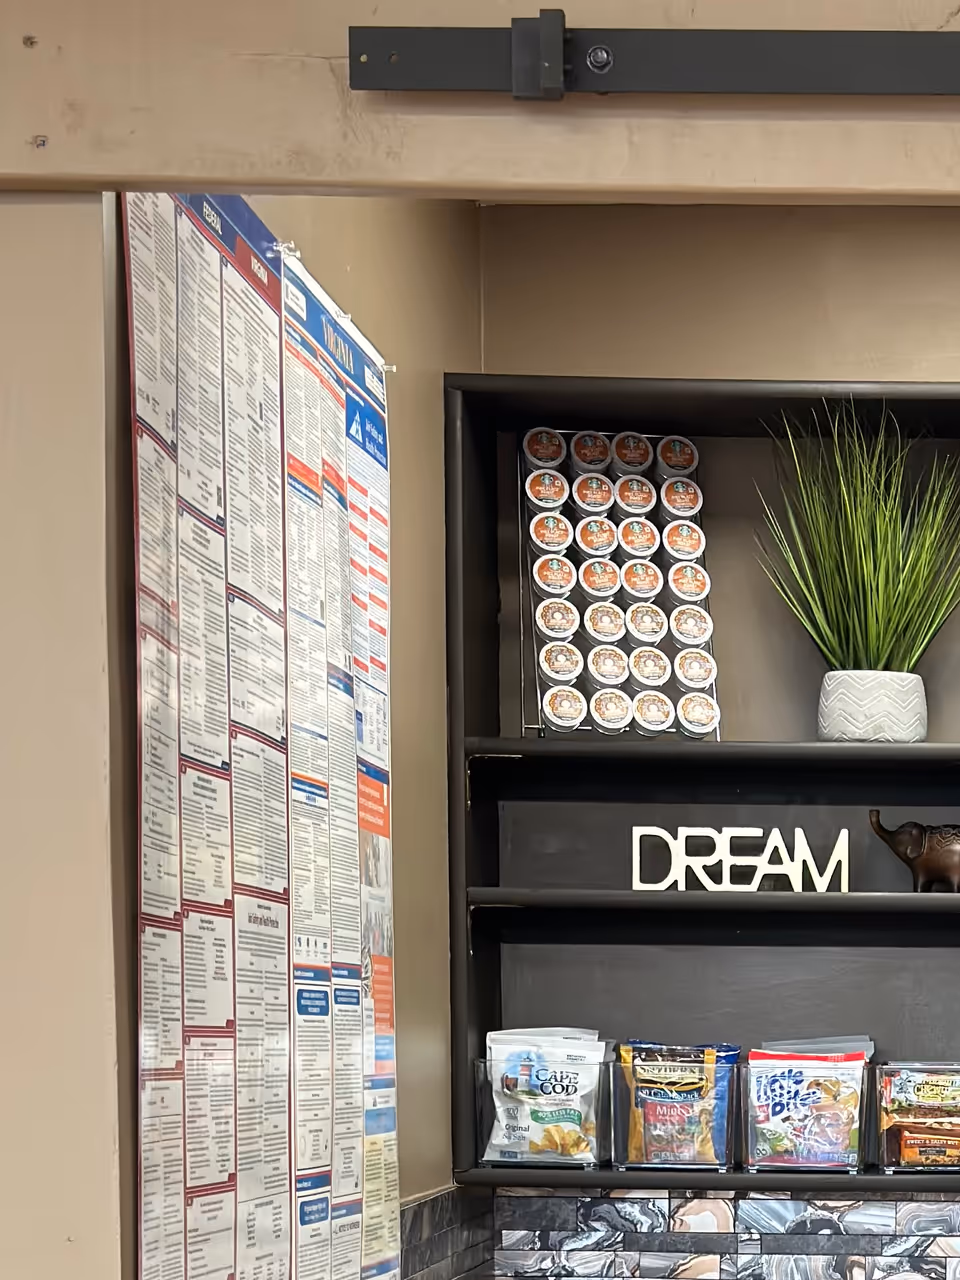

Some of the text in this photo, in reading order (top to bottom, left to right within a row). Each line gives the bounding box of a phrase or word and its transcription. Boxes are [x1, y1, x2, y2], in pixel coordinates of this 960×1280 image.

[320, 314, 354, 375] VIRGINIA
[632, 826, 849, 893] DREAM
[535, 1068, 579, 1085] CAPE
[540, 1081, 578, 1096] COD
[505, 1123, 530, 1132] Original
